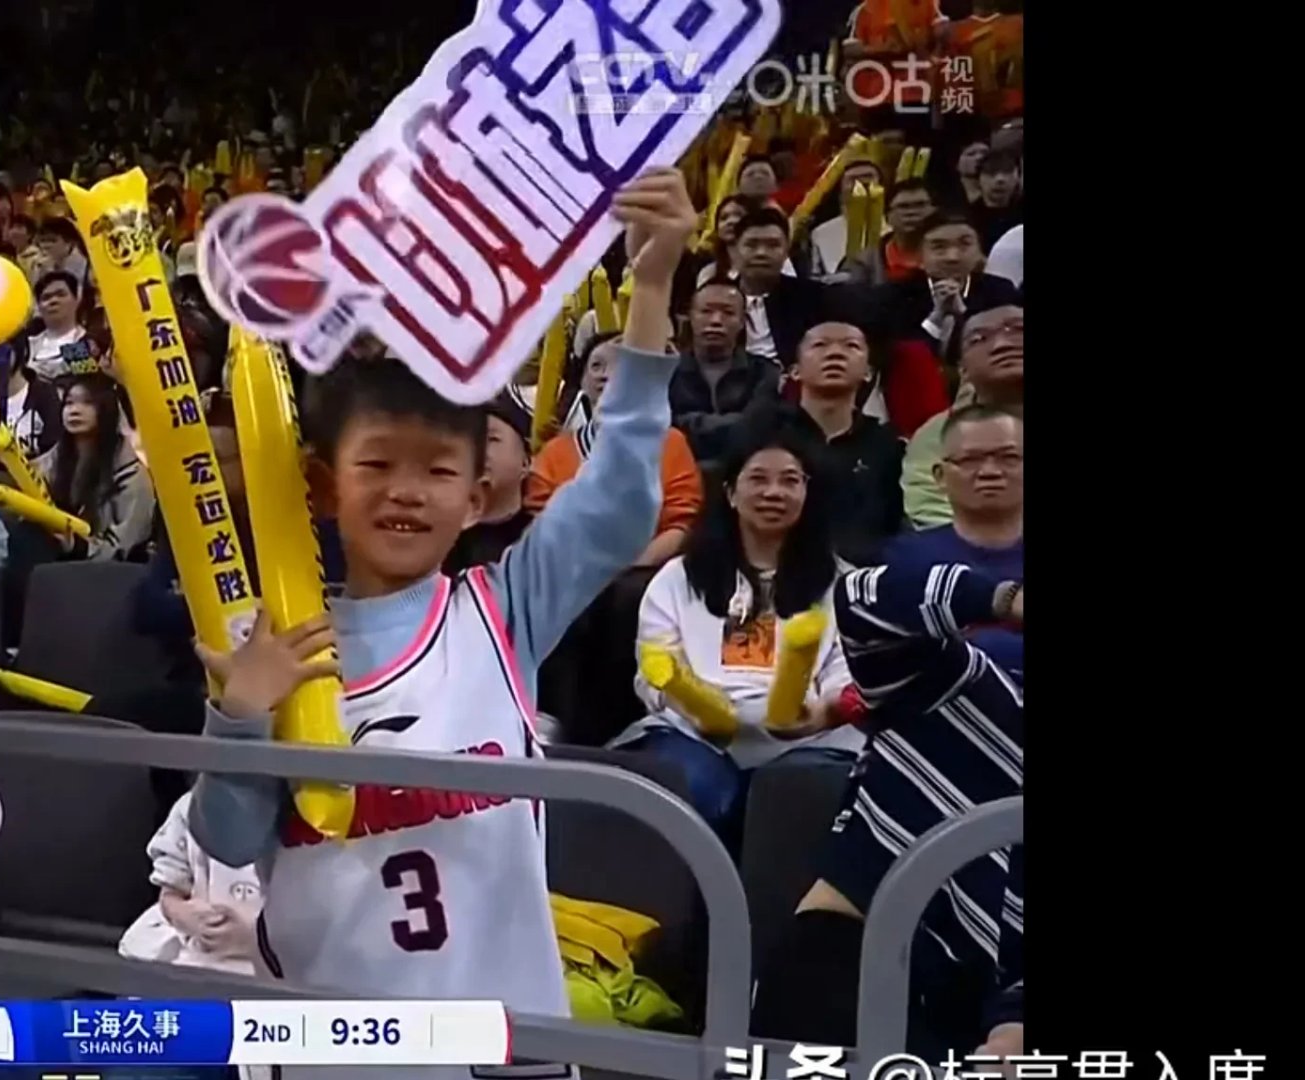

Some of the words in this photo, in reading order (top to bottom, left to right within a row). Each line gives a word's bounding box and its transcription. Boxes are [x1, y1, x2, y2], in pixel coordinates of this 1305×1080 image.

[136, 278, 201, 428] 广东加油
[182, 453, 248, 604] 宏远必胜
[380, 850, 448, 952] 3
